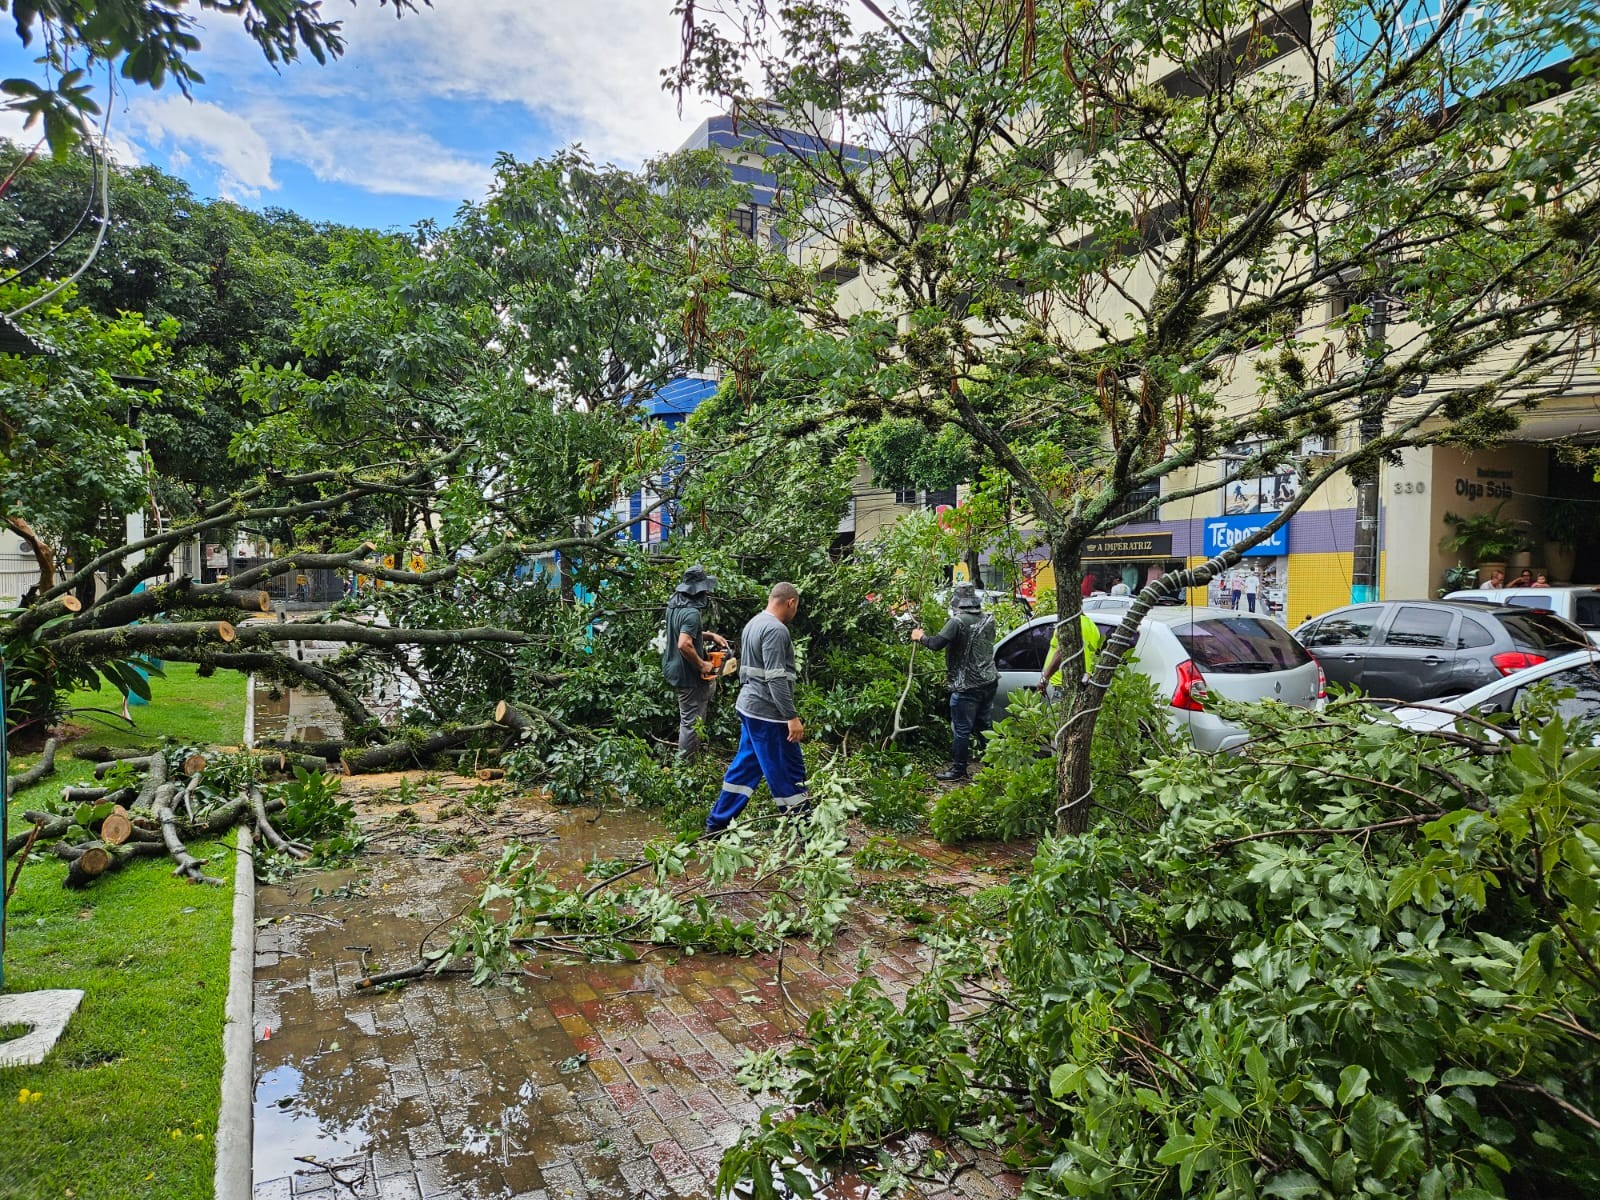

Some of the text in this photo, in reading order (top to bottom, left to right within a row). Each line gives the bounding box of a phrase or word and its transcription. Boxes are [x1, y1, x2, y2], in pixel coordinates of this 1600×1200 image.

[1393, 481, 1426, 495] 330
[1455, 478, 1484, 501] Olga
[1096, 541, 1153, 552] A IMPERATRIZ
